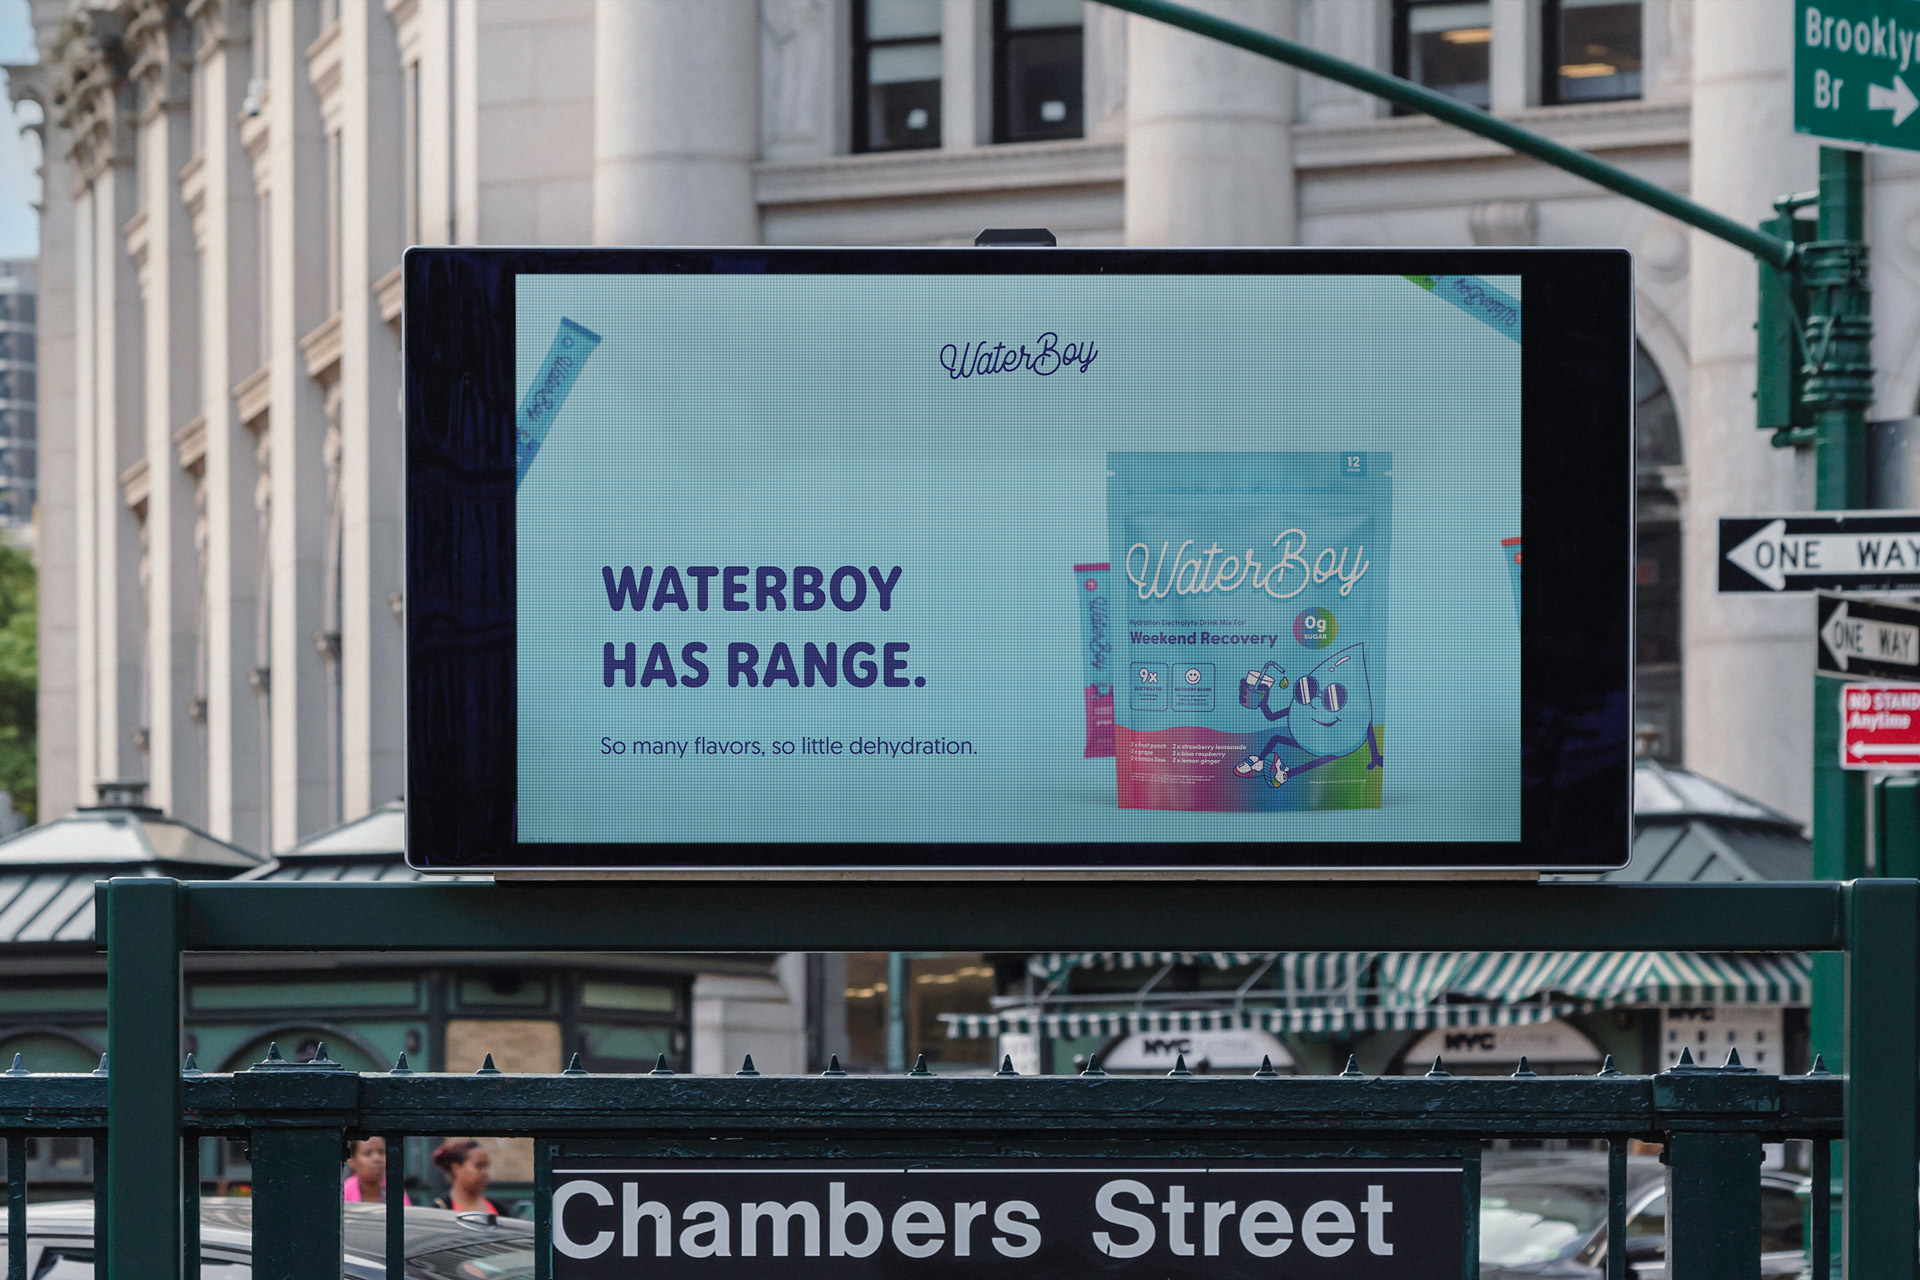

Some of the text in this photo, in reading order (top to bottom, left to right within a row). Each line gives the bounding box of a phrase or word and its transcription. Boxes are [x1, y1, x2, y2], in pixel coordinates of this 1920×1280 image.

[1814, 68, 1844, 110] Br
[940, 332, 1099, 379] WaterBoy
[1347, 455, 1360, 467] 12
[1126, 528, 1370, 600] WaterBoy
[1755, 539, 1920, 569] ONE WAY
[602, 565, 902, 612] WATERBOY
[1129, 619, 1161, 628] Hydration
[1161, 619, 1199, 628] Electrolyte
[1304, 615, 1327, 633] 0g
[1130, 631, 1278, 648] Weekend Recovery
[1833, 620, 1912, 658] ONE WAY
[603, 641, 926, 688] HAS RANGE.
[1139, 667, 1159, 684] 9x
[1847, 692, 1872, 711] NO
[1849, 711, 1911, 733] Anytime
[600, 736, 978, 758] So many flavors, so little dehydration.
[1181, 743, 1214, 751] strawberry
[1142, 1038, 1191, 1055] NYC
[1444, 1032, 1495, 1050] NYC
[552, 1179, 1394, 1259] Chambers Street
